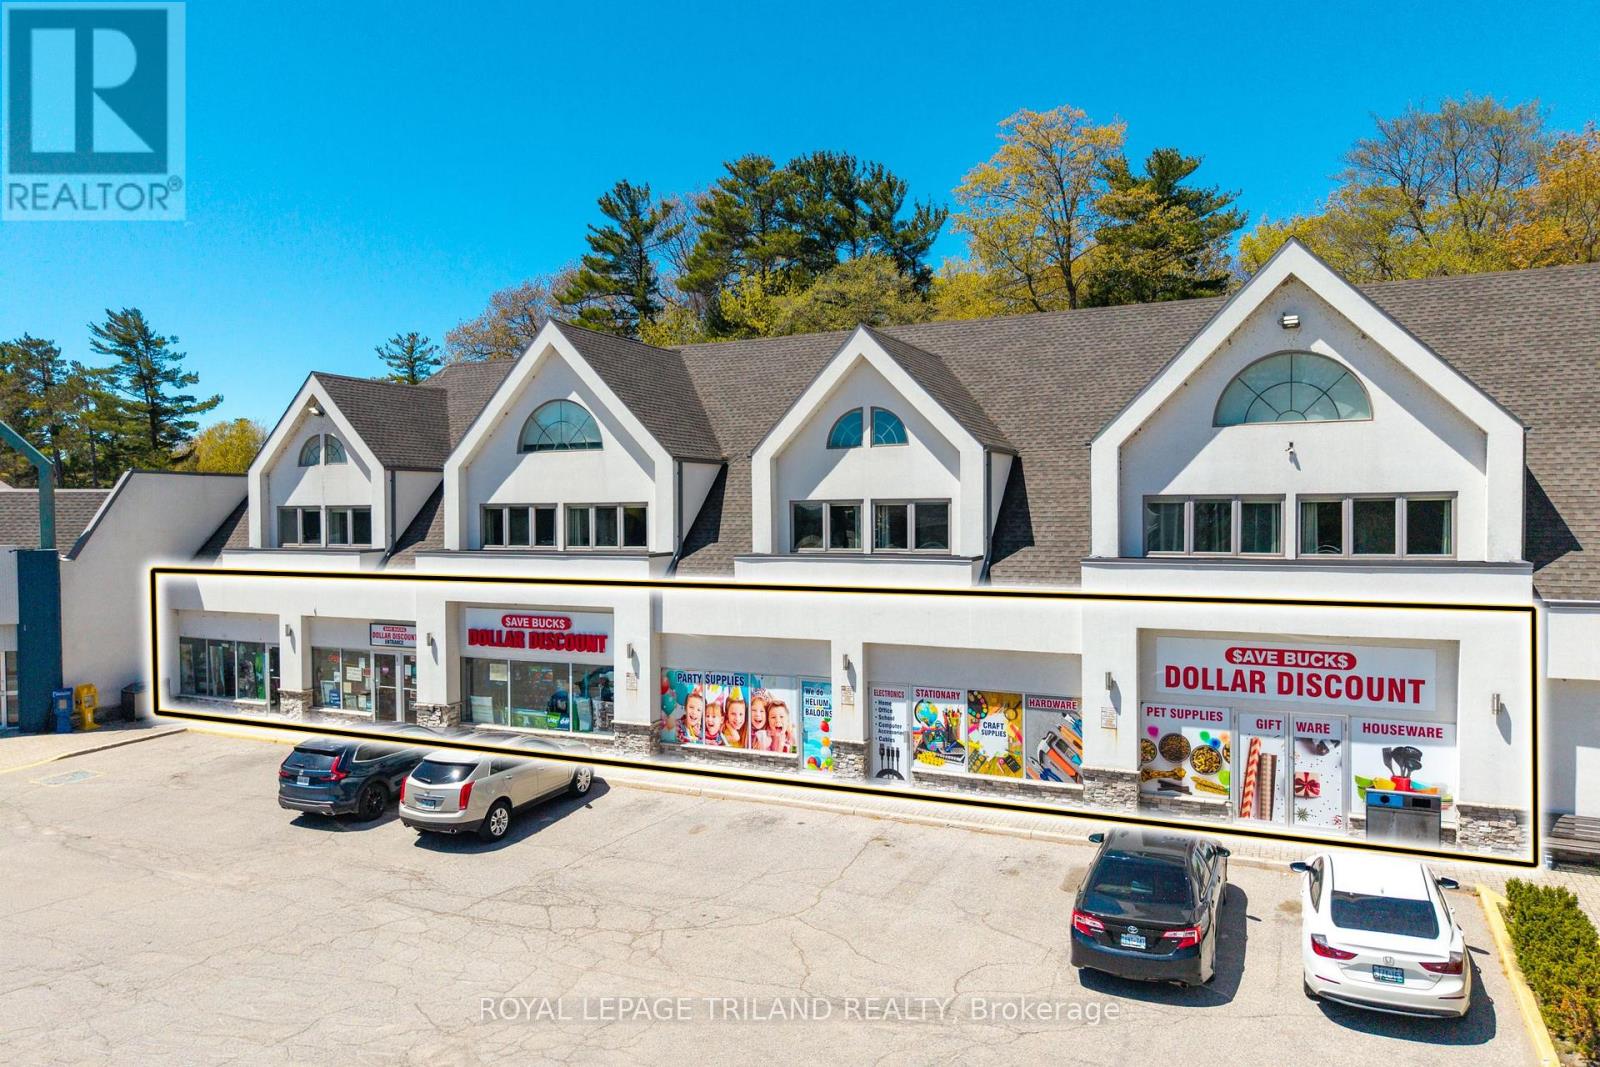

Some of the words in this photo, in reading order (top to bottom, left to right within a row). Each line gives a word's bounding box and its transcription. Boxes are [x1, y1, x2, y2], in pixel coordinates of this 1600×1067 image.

[468, 629, 525, 648] DOLLAR
[528, 631, 608, 653] DISCOUNT
[677, 672, 702, 685] PARTY
[705, 674, 745, 686] SUPPLIES
[1165, 665, 1266, 694] DOLLAR
[1277, 671, 1426, 704] DISCOUNT
[805, 688, 815, 696] We
[873, 688, 905, 699] ELECTRONICS
[915, 688, 961, 700] STATIONARY
[805, 697, 829, 707] HELIUM
[878, 699, 892, 707] Home
[1029, 698, 1078, 710] HARDWARE
[805, 708, 833, 719] BALOONS
[1146, 706, 1167, 719] PET
[1170, 708, 1223, 722] SUPPLIES
[878, 721, 903, 730] Computer
[983, 721, 1005, 731] CRAFT
[1256, 718, 1282, 731] GIFT
[1296, 721, 1331, 734] WARE
[1362, 723, 1444, 738] HOUSEWARE
[878, 735, 896, 743] Cables
[981, 729, 1008, 738] SUPPLIES
